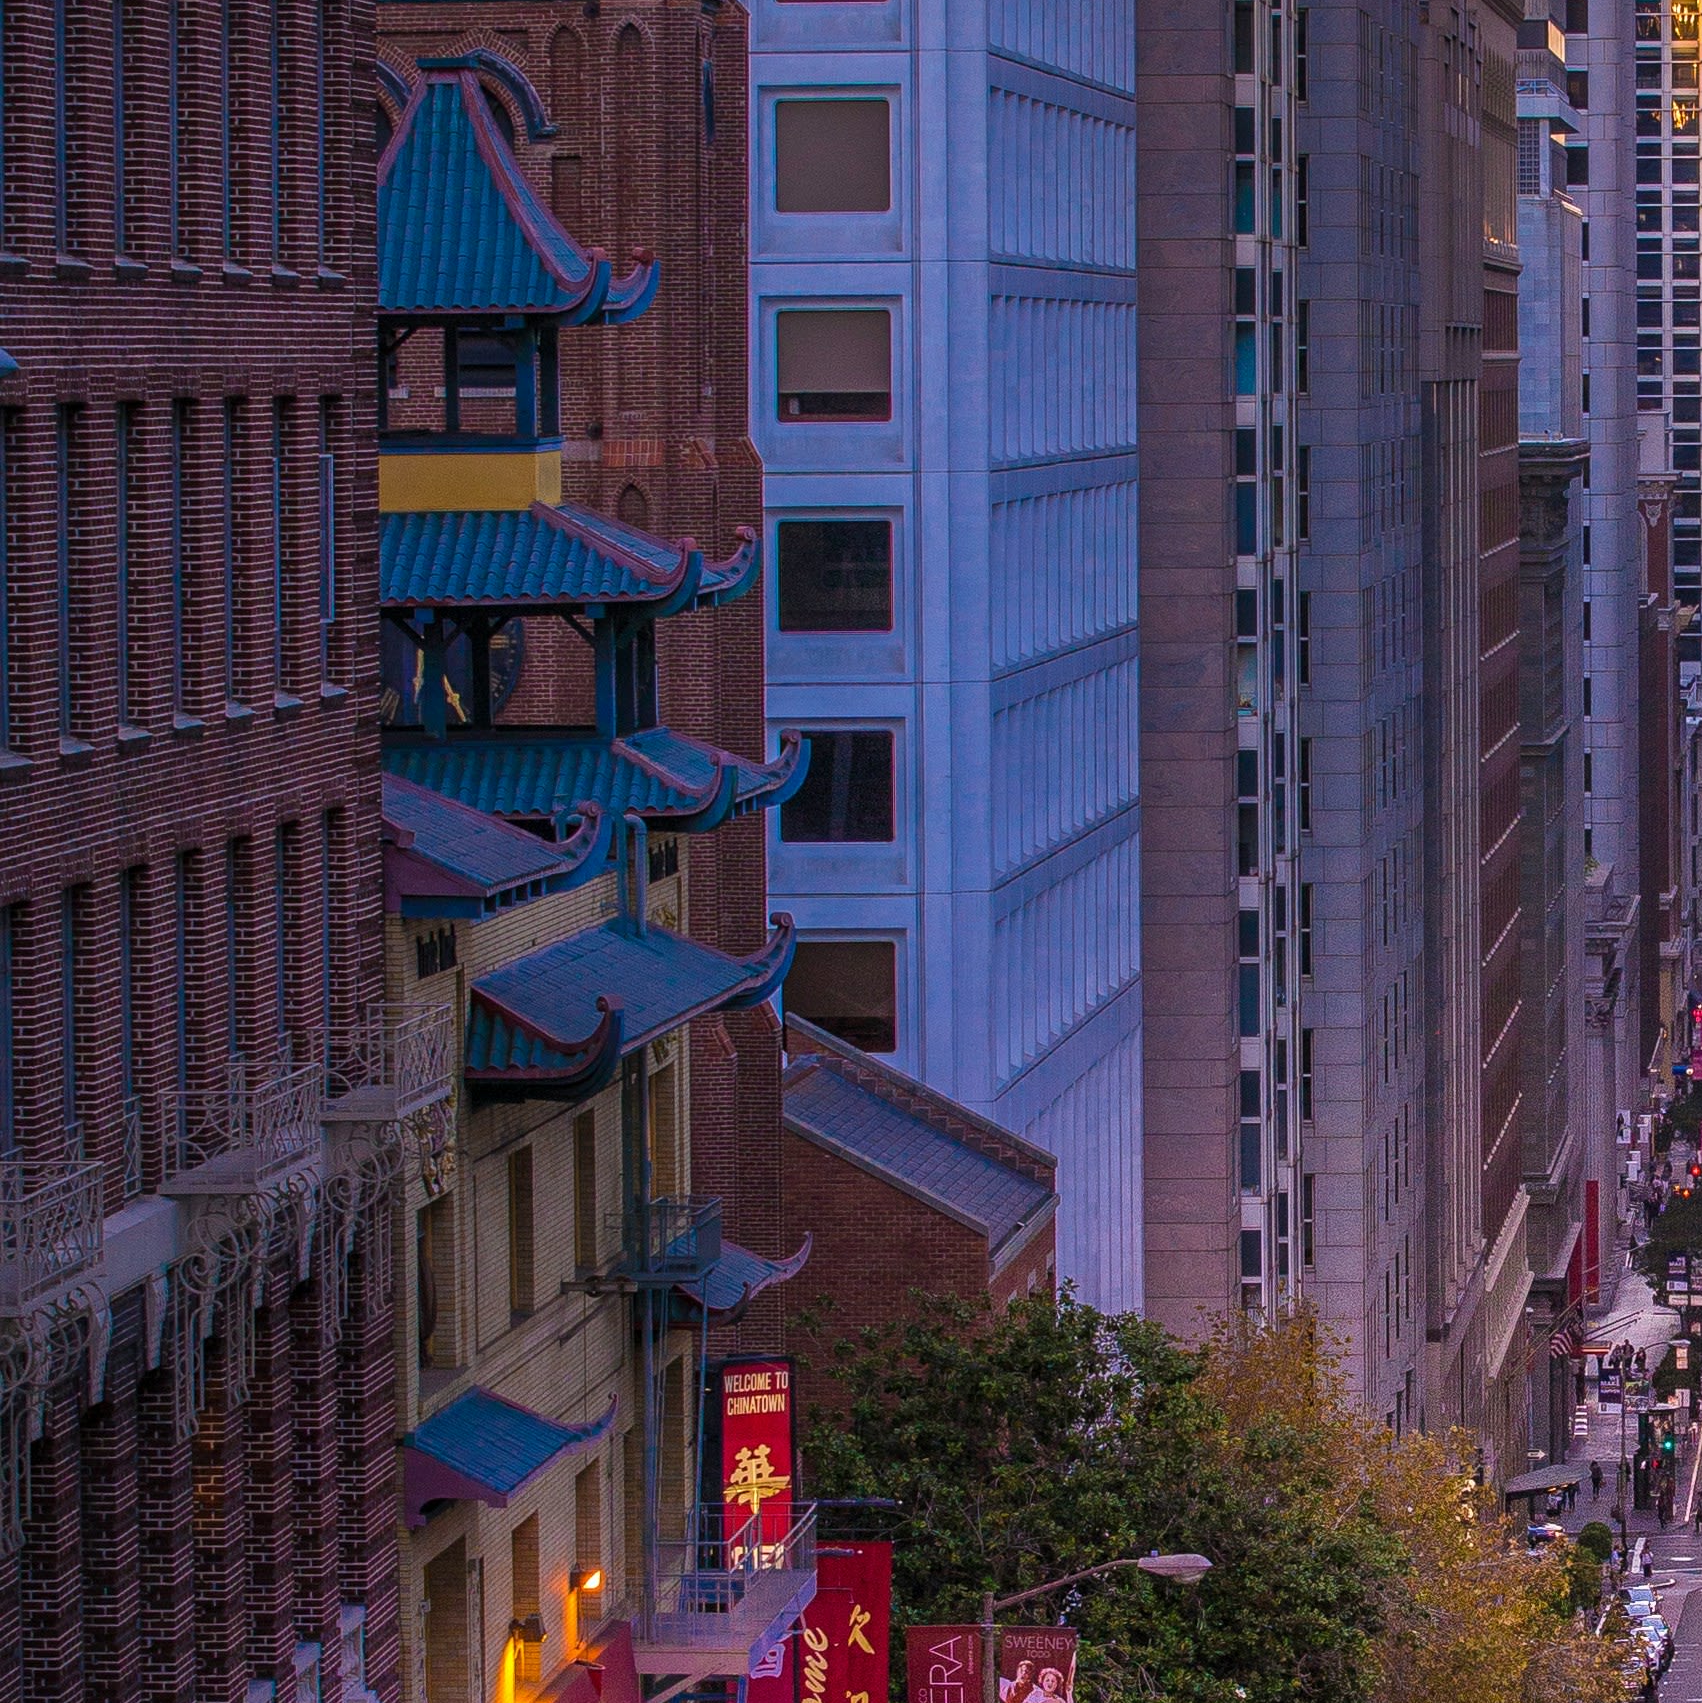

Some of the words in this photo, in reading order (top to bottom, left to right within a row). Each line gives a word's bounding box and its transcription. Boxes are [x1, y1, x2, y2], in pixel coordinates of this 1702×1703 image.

[724, 1372, 771, 1393] WELCOME
[774, 1371, 789, 1390] TO
[727, 1394, 785, 1416] CHINATOWN
[1005, 1636, 1073, 1650] SWEENEY
[1026, 1650, 1050, 1659] TODD
